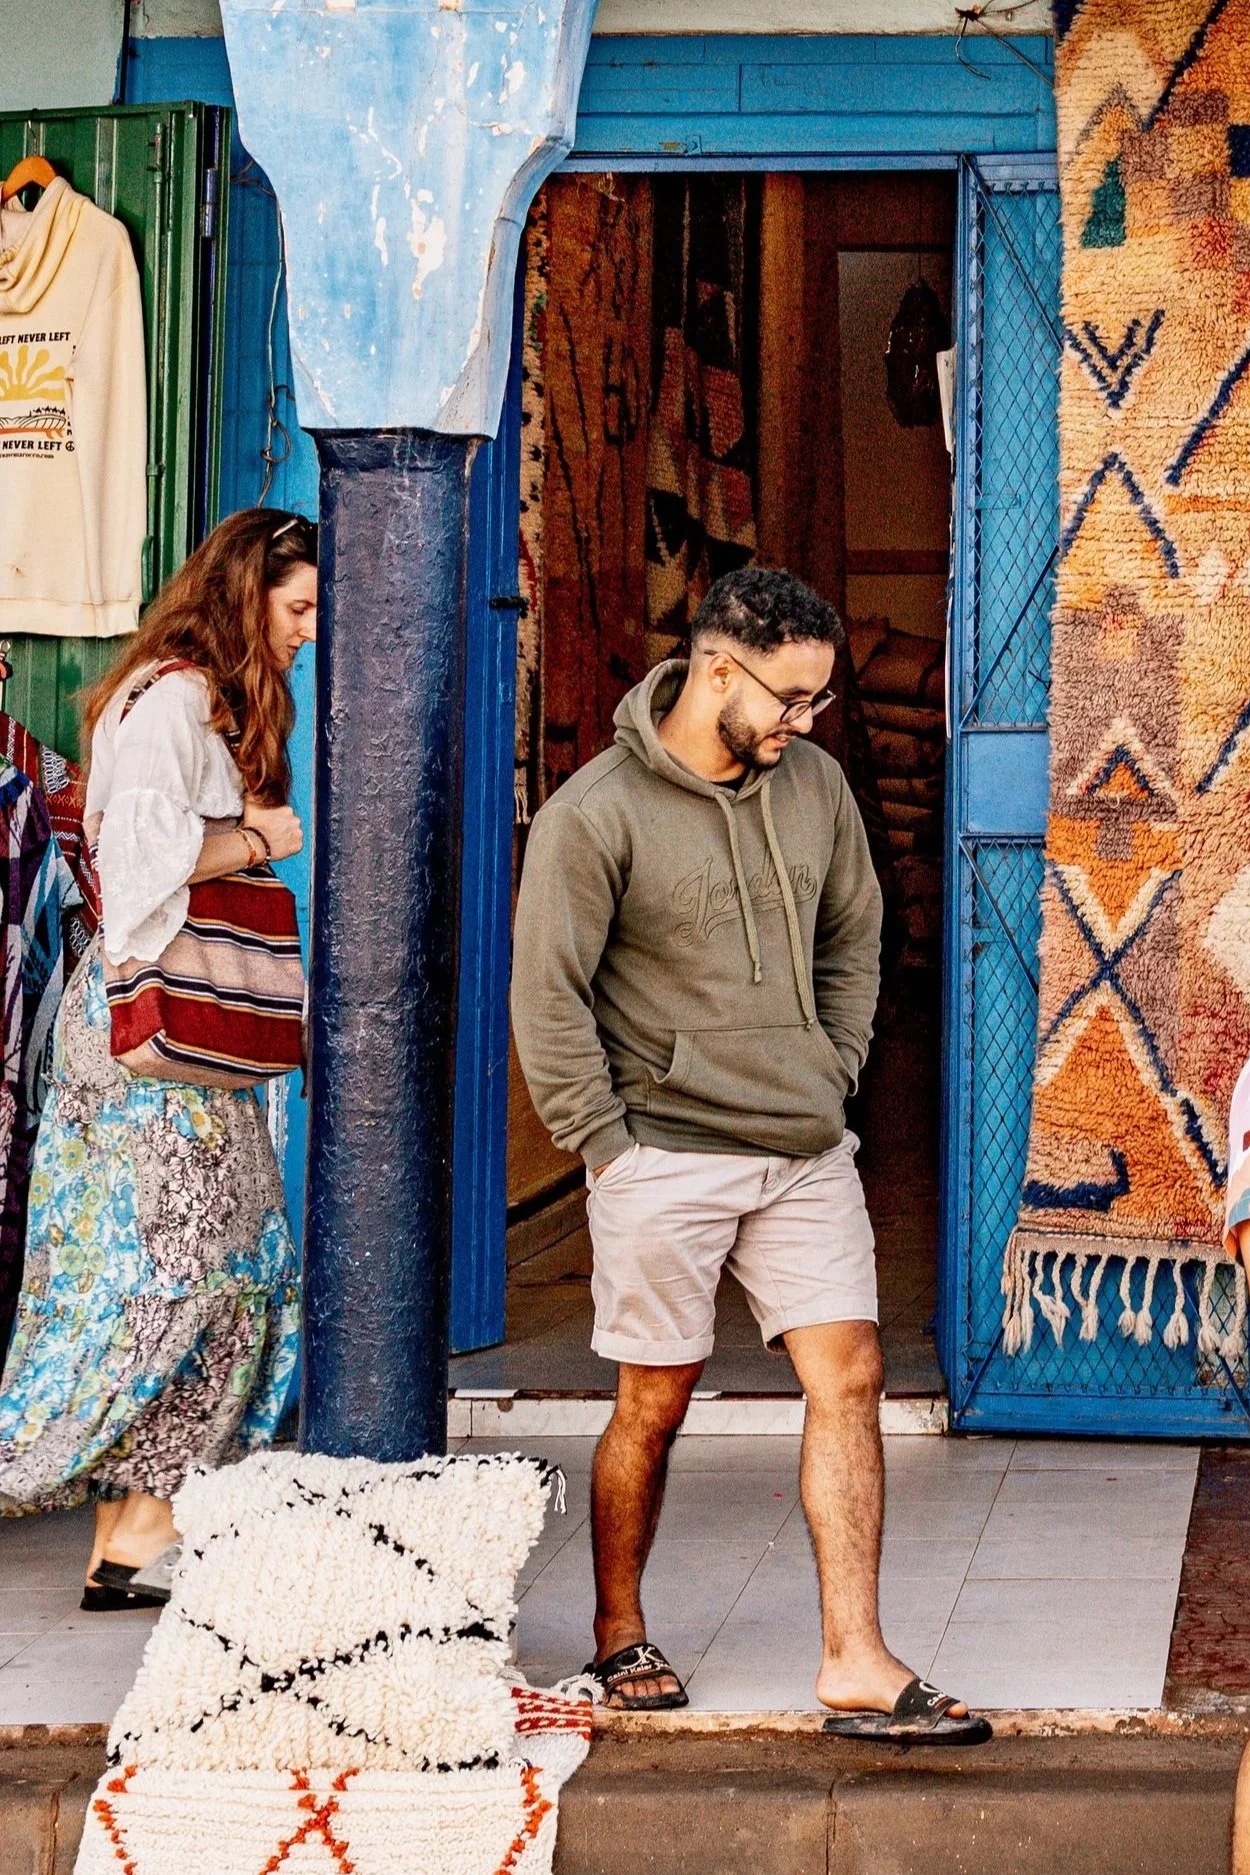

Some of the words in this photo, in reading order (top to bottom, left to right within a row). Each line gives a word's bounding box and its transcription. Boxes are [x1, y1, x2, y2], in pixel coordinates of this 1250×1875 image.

[17, 333, 46, 343] NEVER
[49, 331, 71, 341] LEFT
[2, 440, 35, 450] NEVER
[38, 441, 62, 451] LEFT
